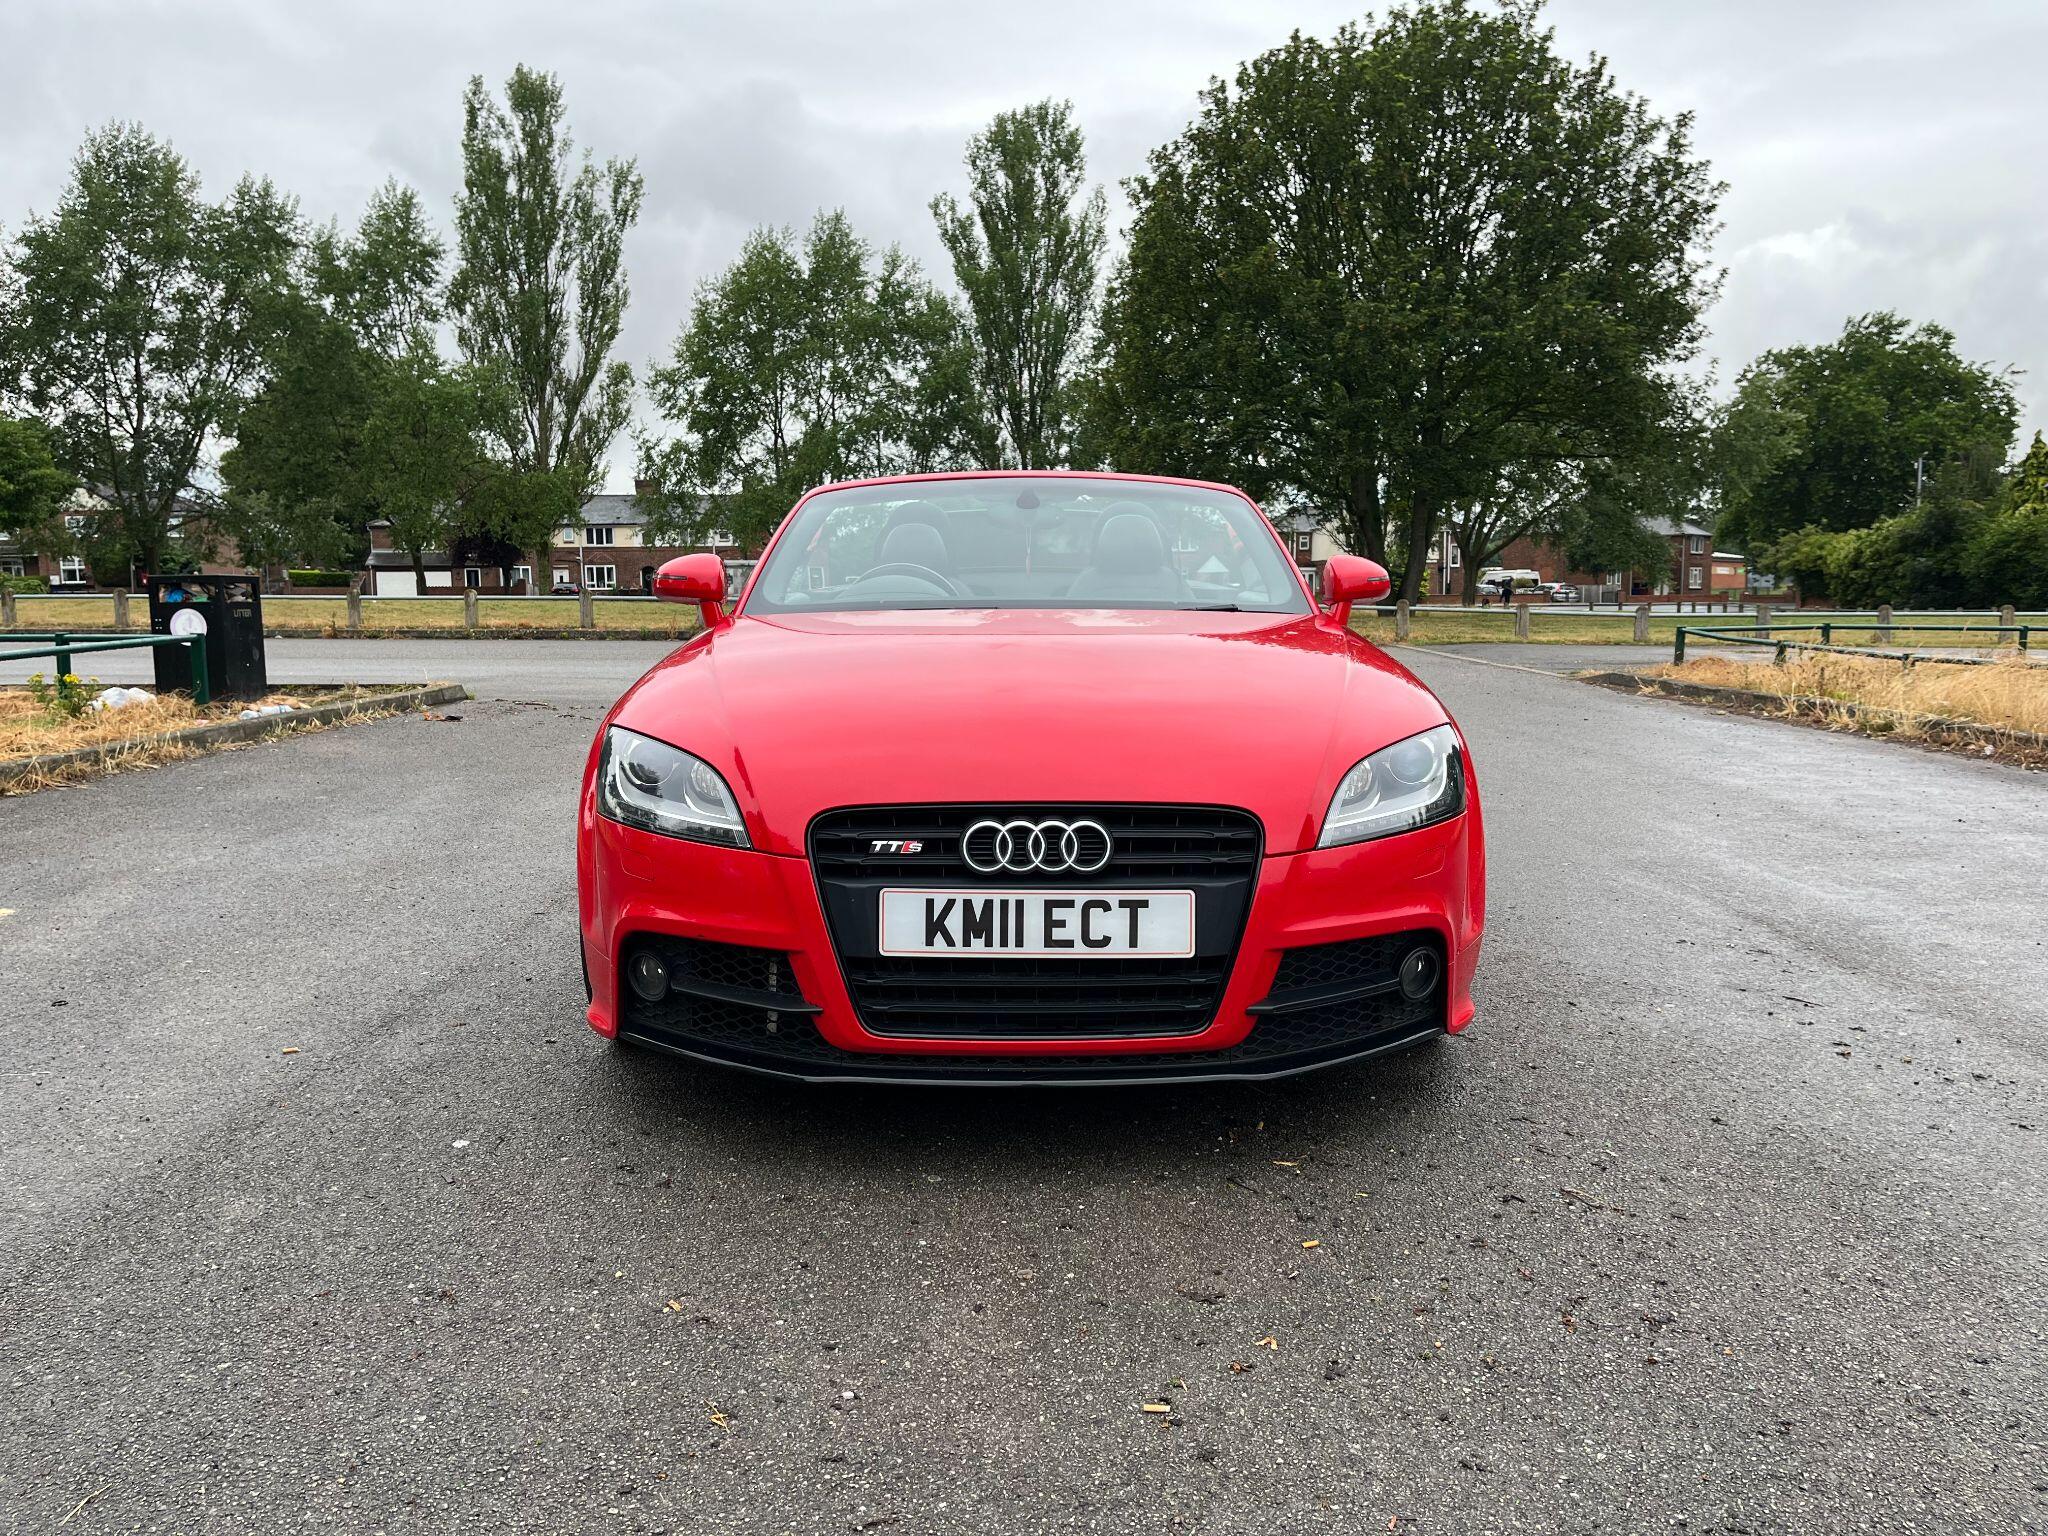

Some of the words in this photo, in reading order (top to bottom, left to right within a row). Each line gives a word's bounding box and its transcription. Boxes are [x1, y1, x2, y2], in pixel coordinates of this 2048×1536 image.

[233, 608, 252, 618] LITTER
[871, 840, 923, 853] TTS
[925, 898, 1025, 948] KM11
[1043, 899, 1150, 949] ECT
